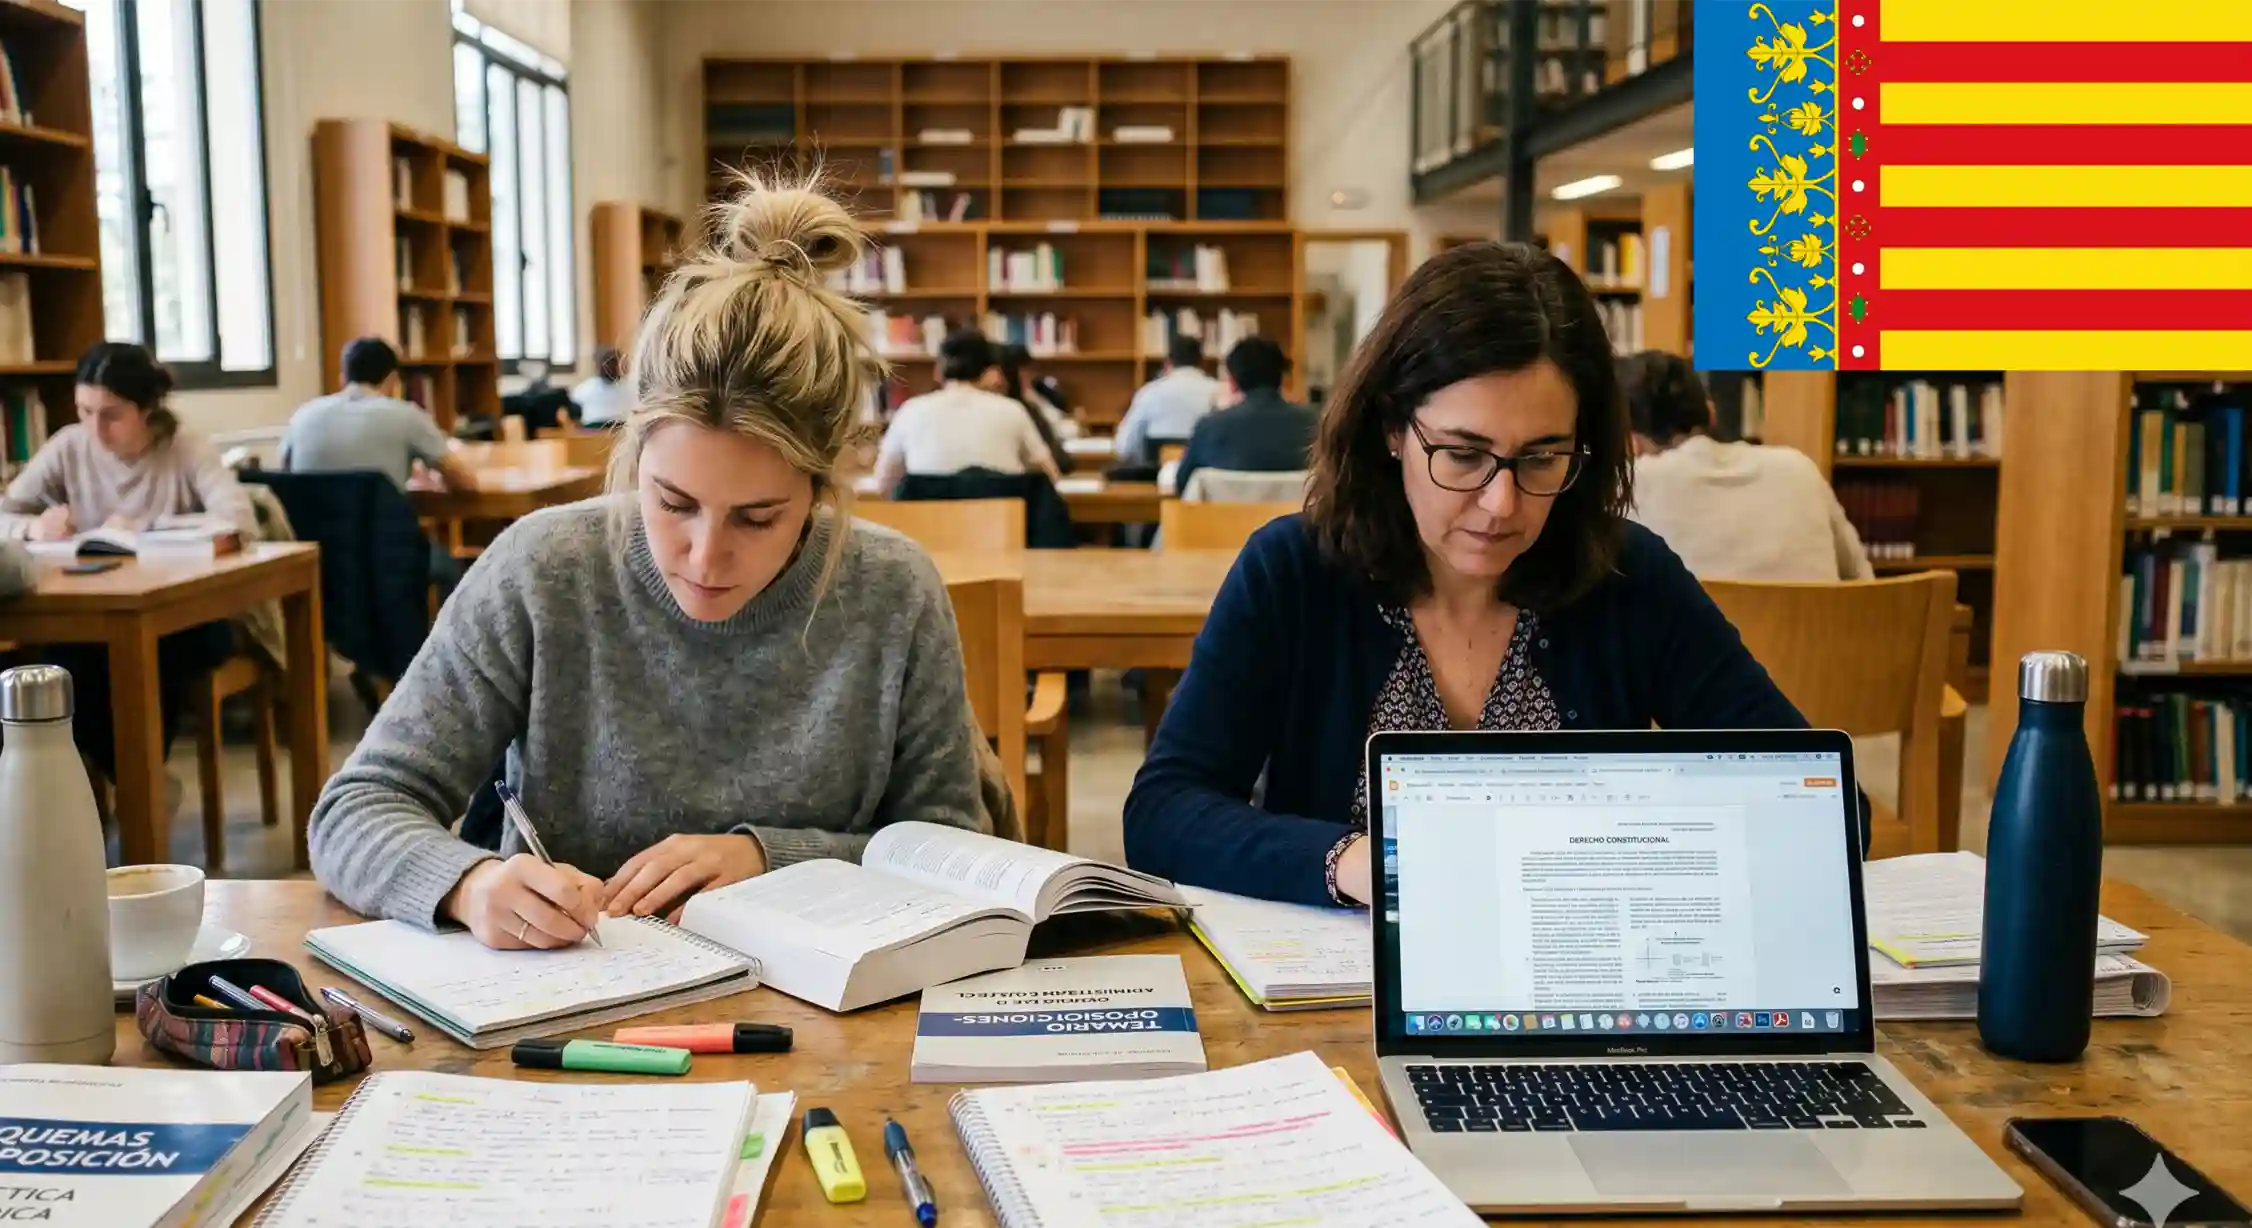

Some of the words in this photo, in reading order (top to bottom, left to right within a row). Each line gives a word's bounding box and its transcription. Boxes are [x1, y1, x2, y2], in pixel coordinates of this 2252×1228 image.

[1569, 836, 1605, 844] DERECHO
[1606, 836, 1670, 844] CONSTITUCIONAL
[1046, 1021, 1162, 1032] TEMARIO
[0, 1186, 75, 1201] TICA
